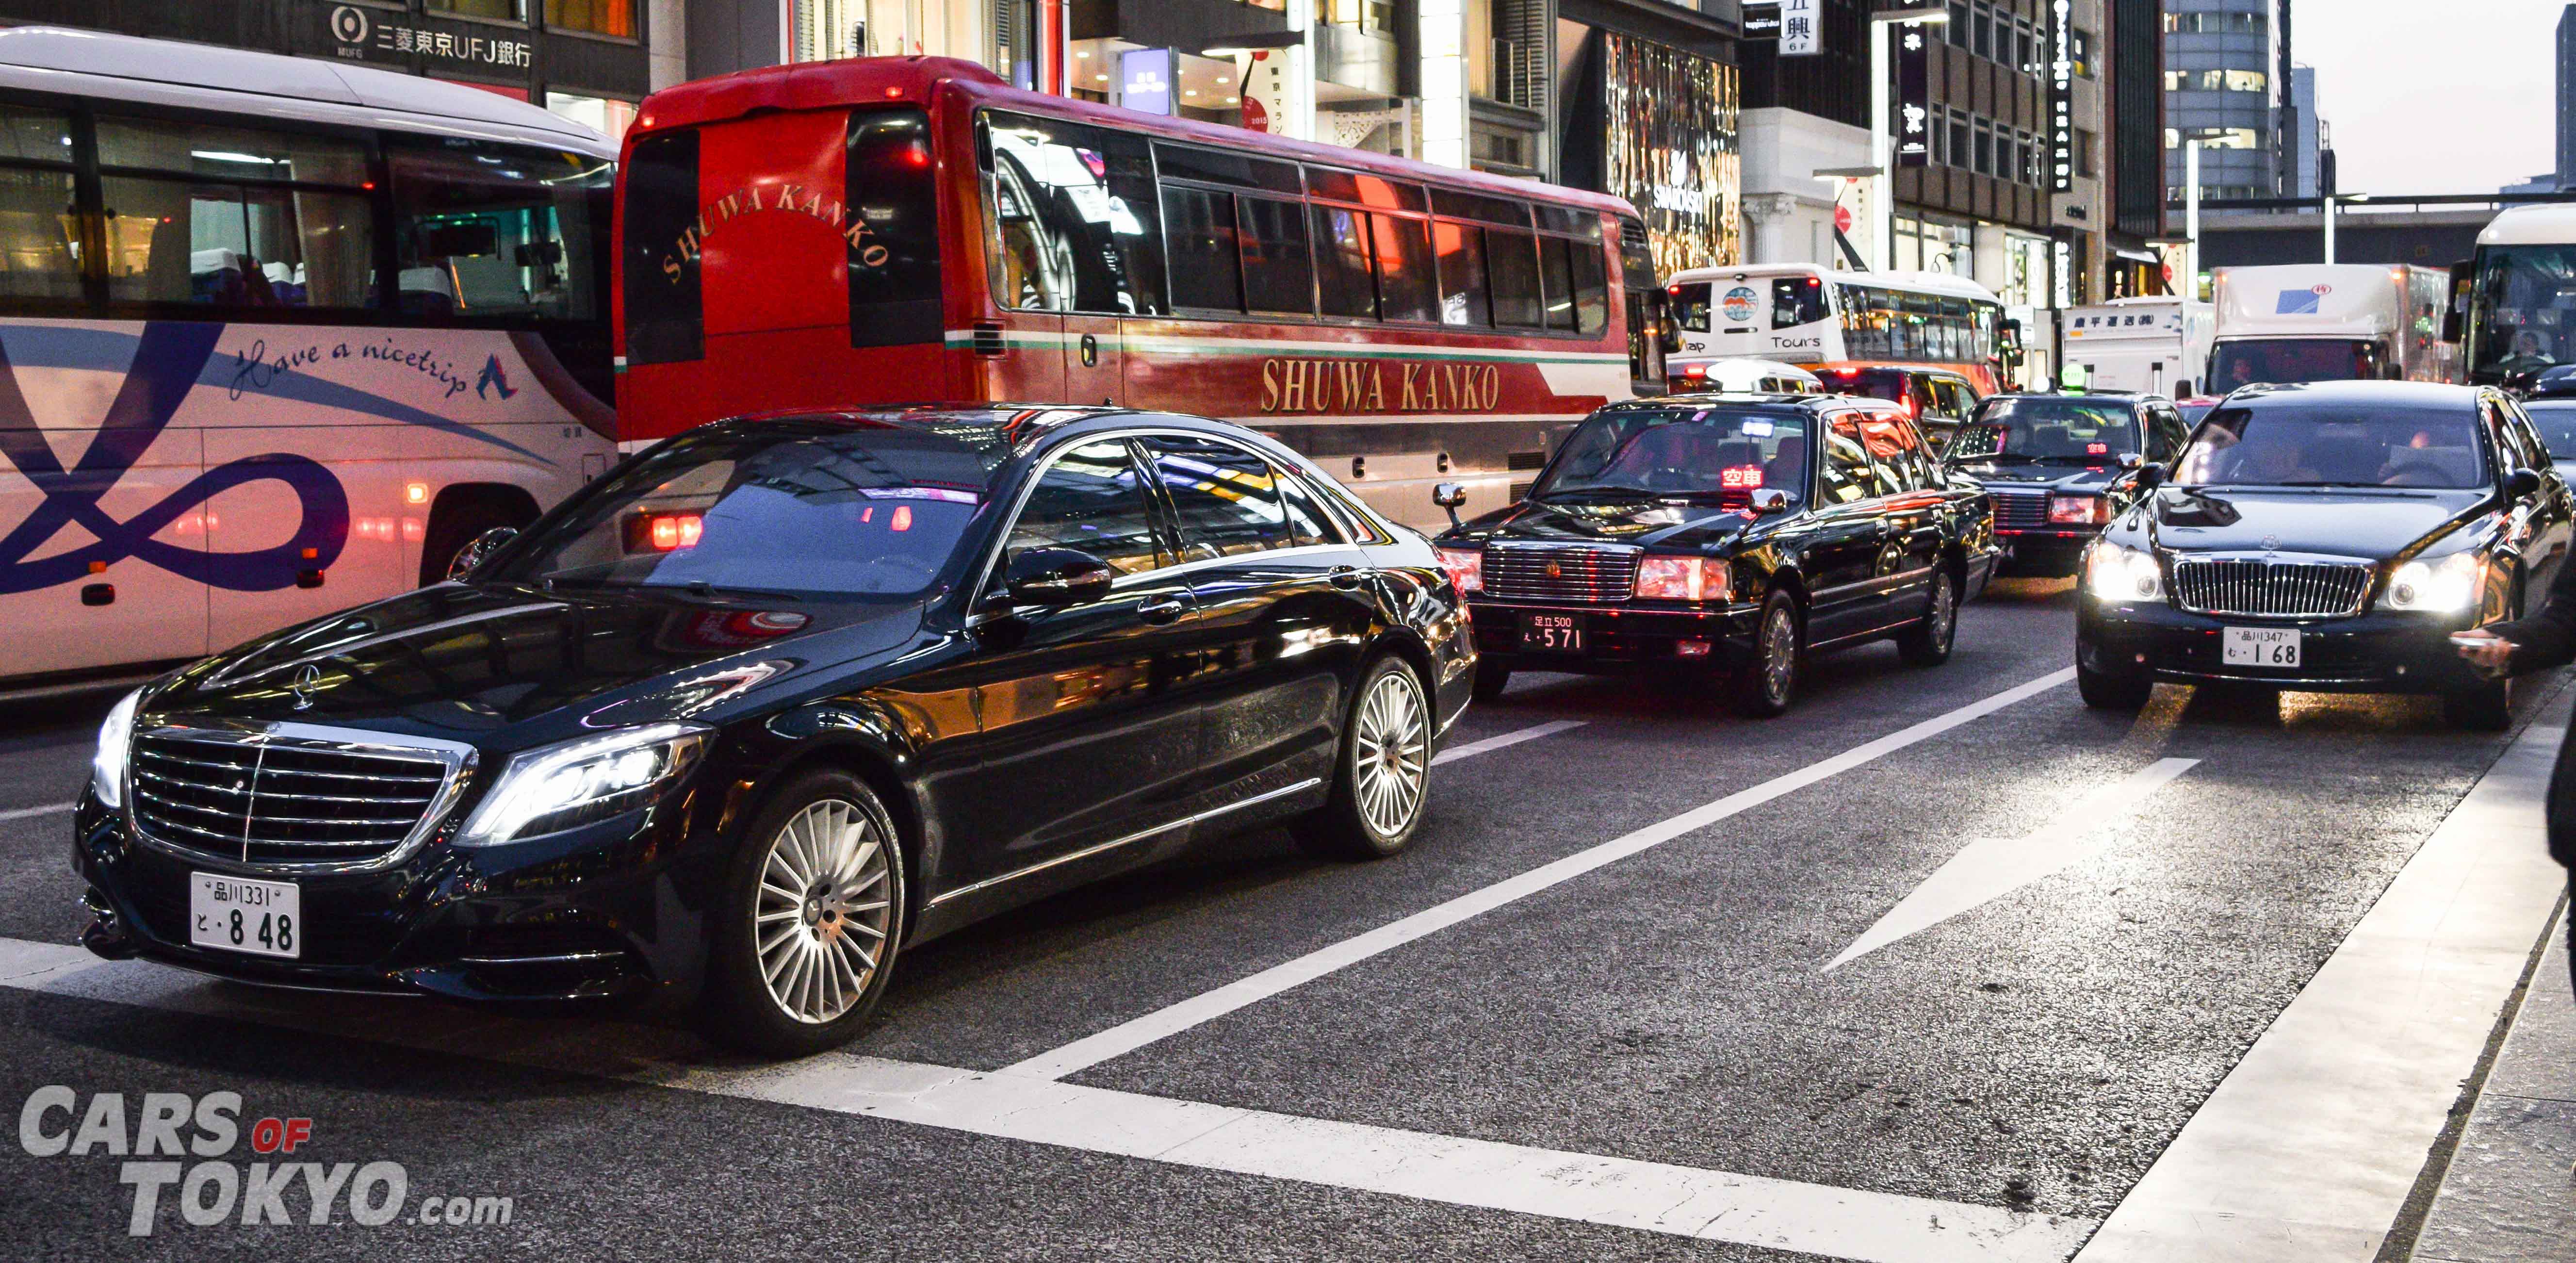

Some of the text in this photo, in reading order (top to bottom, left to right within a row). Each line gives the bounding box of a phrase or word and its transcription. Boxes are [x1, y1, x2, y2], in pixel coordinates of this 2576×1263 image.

[338, 47, 363, 59] MUFG
[377, 24, 532, 67] 三菱東京UFJ銀行
[663, 184, 888, 285] SHUWA KANKO
[1771, 336, 1820, 348] Tours
[230, 338, 467, 401] Have a nicetrip
[1261, 359, 1499, 412] SHUWA KANKO
[1723, 468, 1761, 486] 空車
